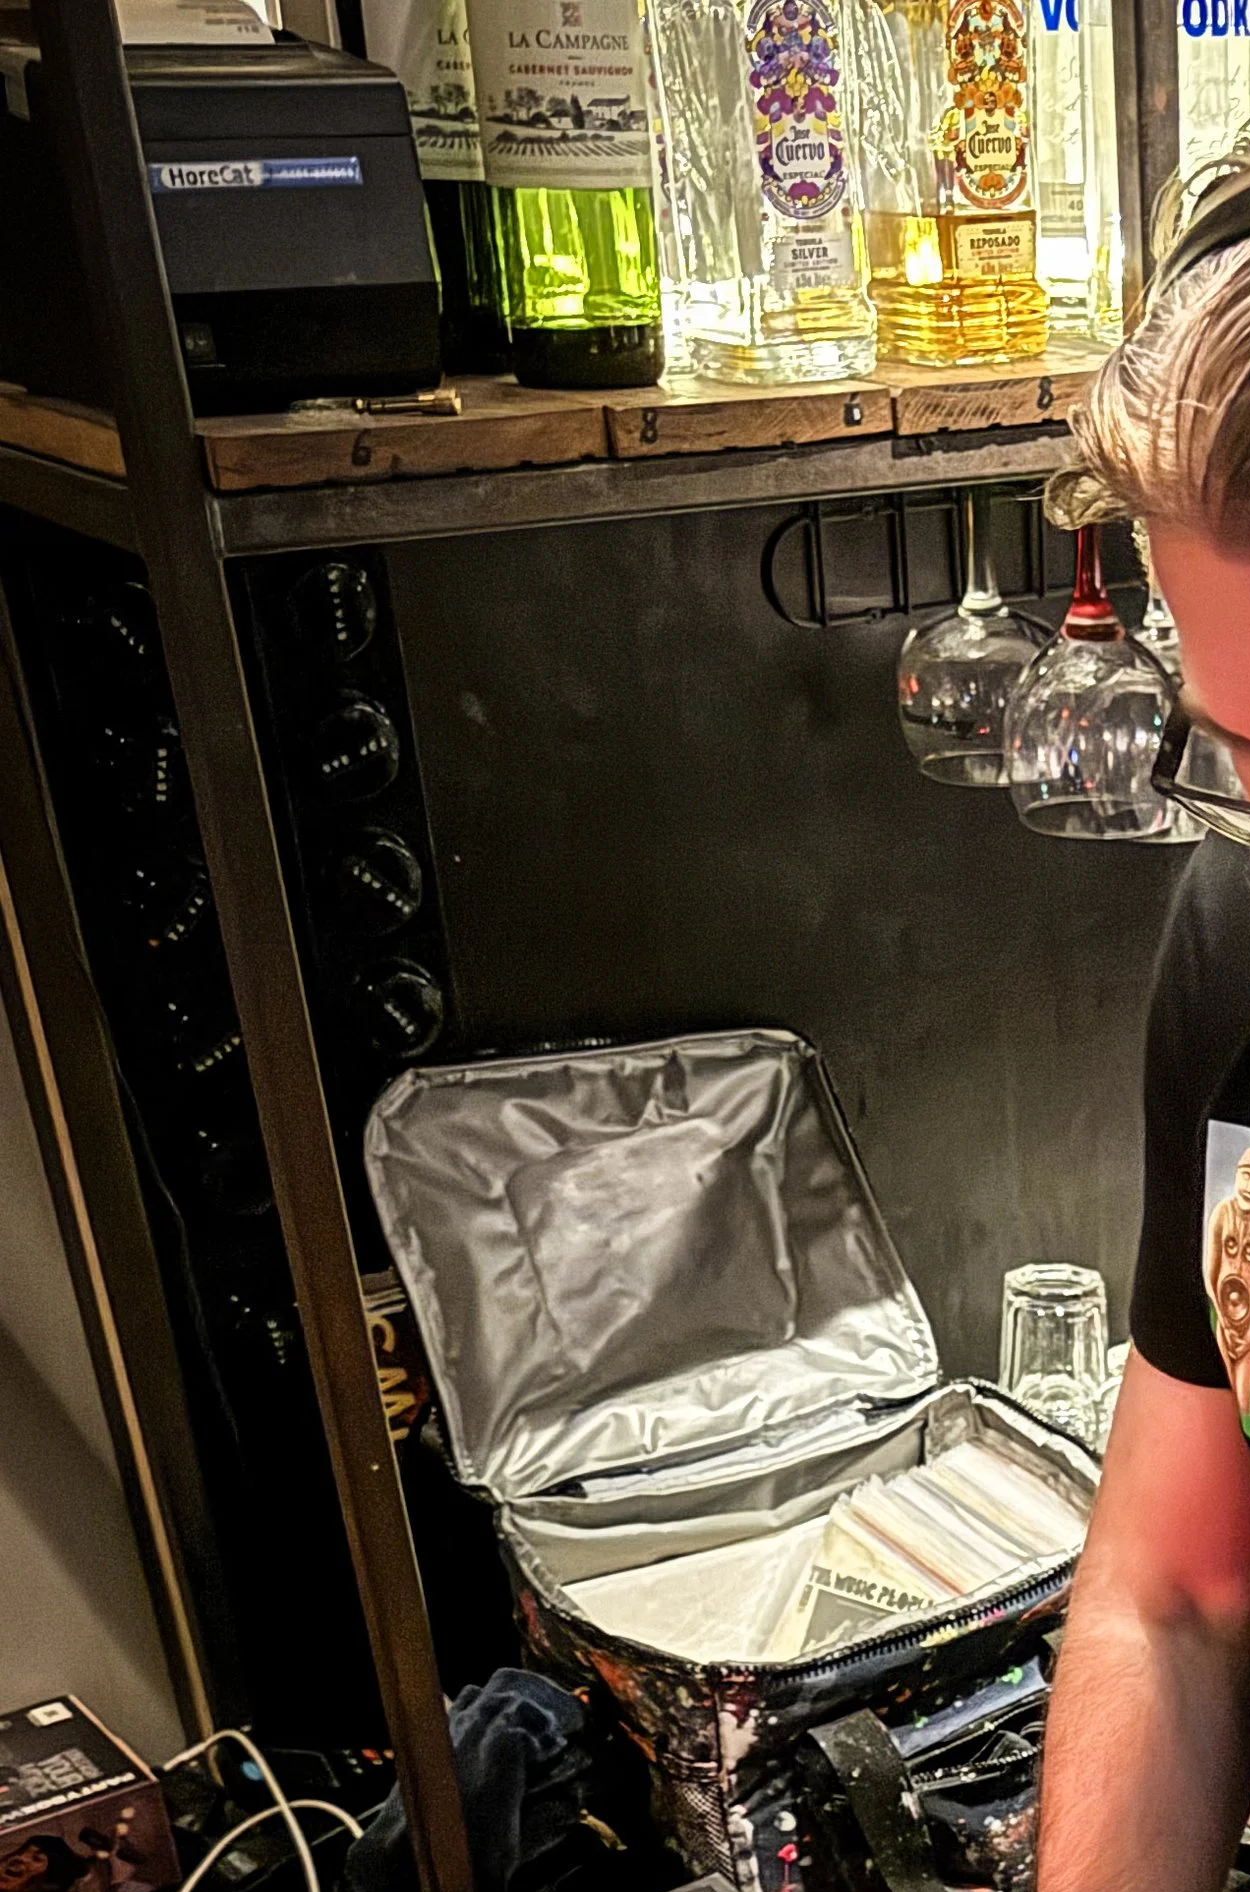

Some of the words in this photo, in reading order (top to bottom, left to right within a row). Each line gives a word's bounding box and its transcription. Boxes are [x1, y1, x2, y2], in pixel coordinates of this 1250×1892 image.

[437, 28, 458, 45] LA
[508, 31, 530, 49] LA
[535, 28, 629, 50] CAMPAGNE
[508, 63, 570, 75] CABERNET
[775, 137, 826, 166] Cuervo
[967, 131, 1012, 158] Cuervo
[168, 164, 255, 187] HoreCat
[782, 171, 826, 181] ESPECIAL
[969, 236, 1021, 249] REPOSADO
[791, 247, 829, 260] SILVER
[833, 1572, 878, 1601] MUSIC
